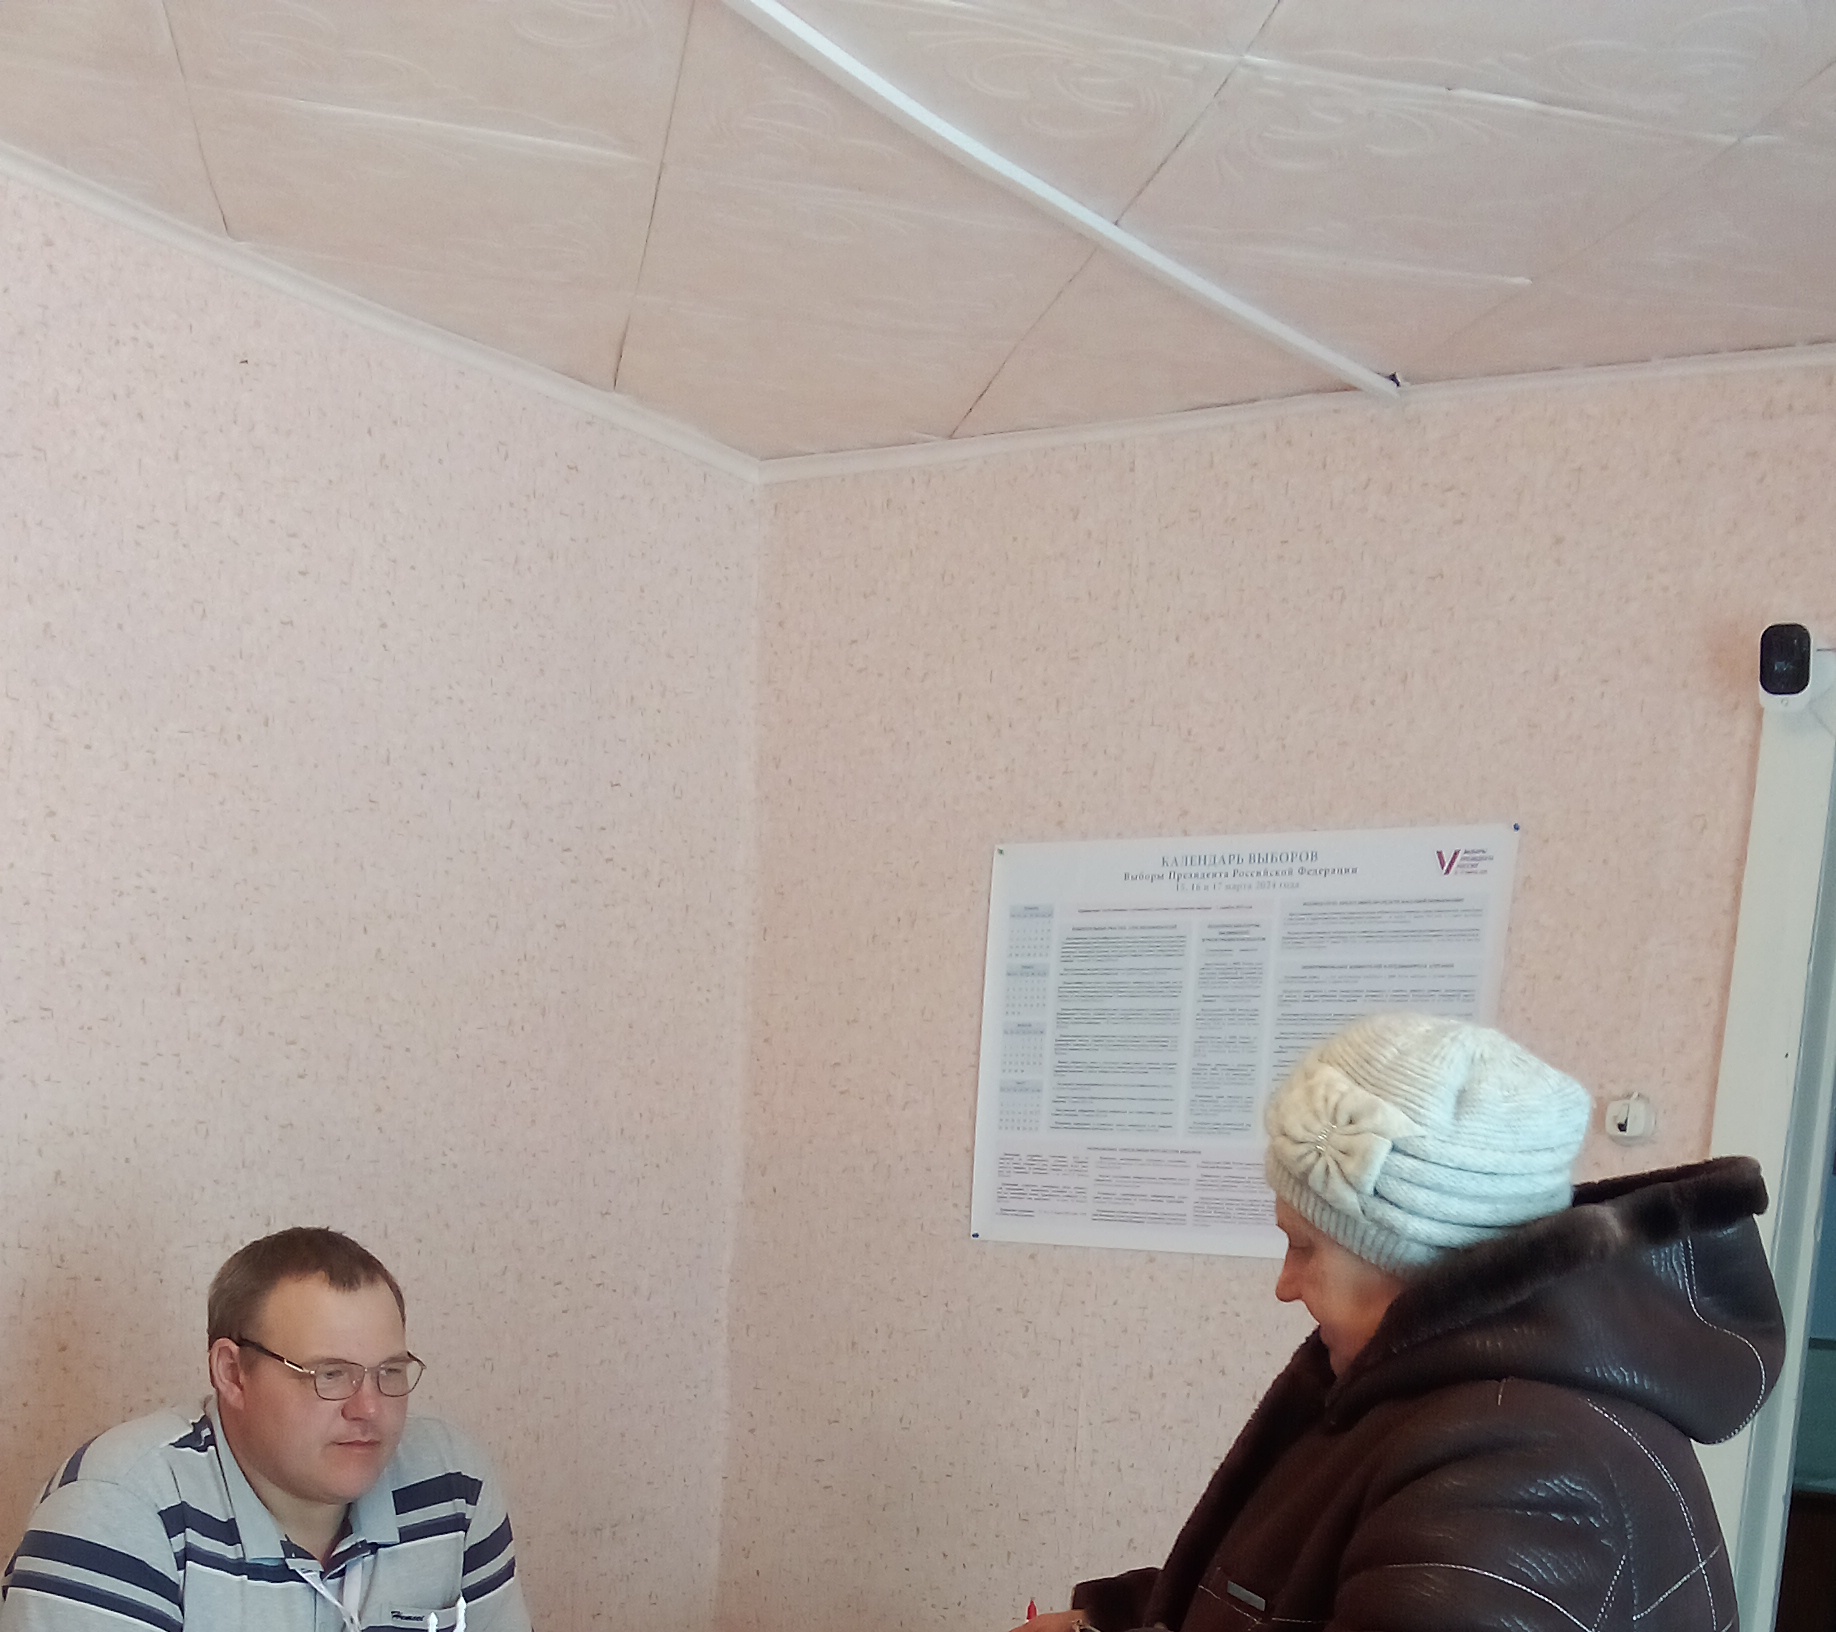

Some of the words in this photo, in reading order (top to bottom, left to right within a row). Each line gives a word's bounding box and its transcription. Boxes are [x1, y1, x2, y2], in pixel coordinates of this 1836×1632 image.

[1161, 854, 1244, 868] КАЛЕНДАРЬ
[1248, 851, 1318, 864] ВЫБОРОВ
[1123, 871, 1165, 883] Выборы
[1168, 868, 1229, 882] Президента
[1232, 867, 1294, 878] Российской
[1297, 866, 1358, 877] Федерации
